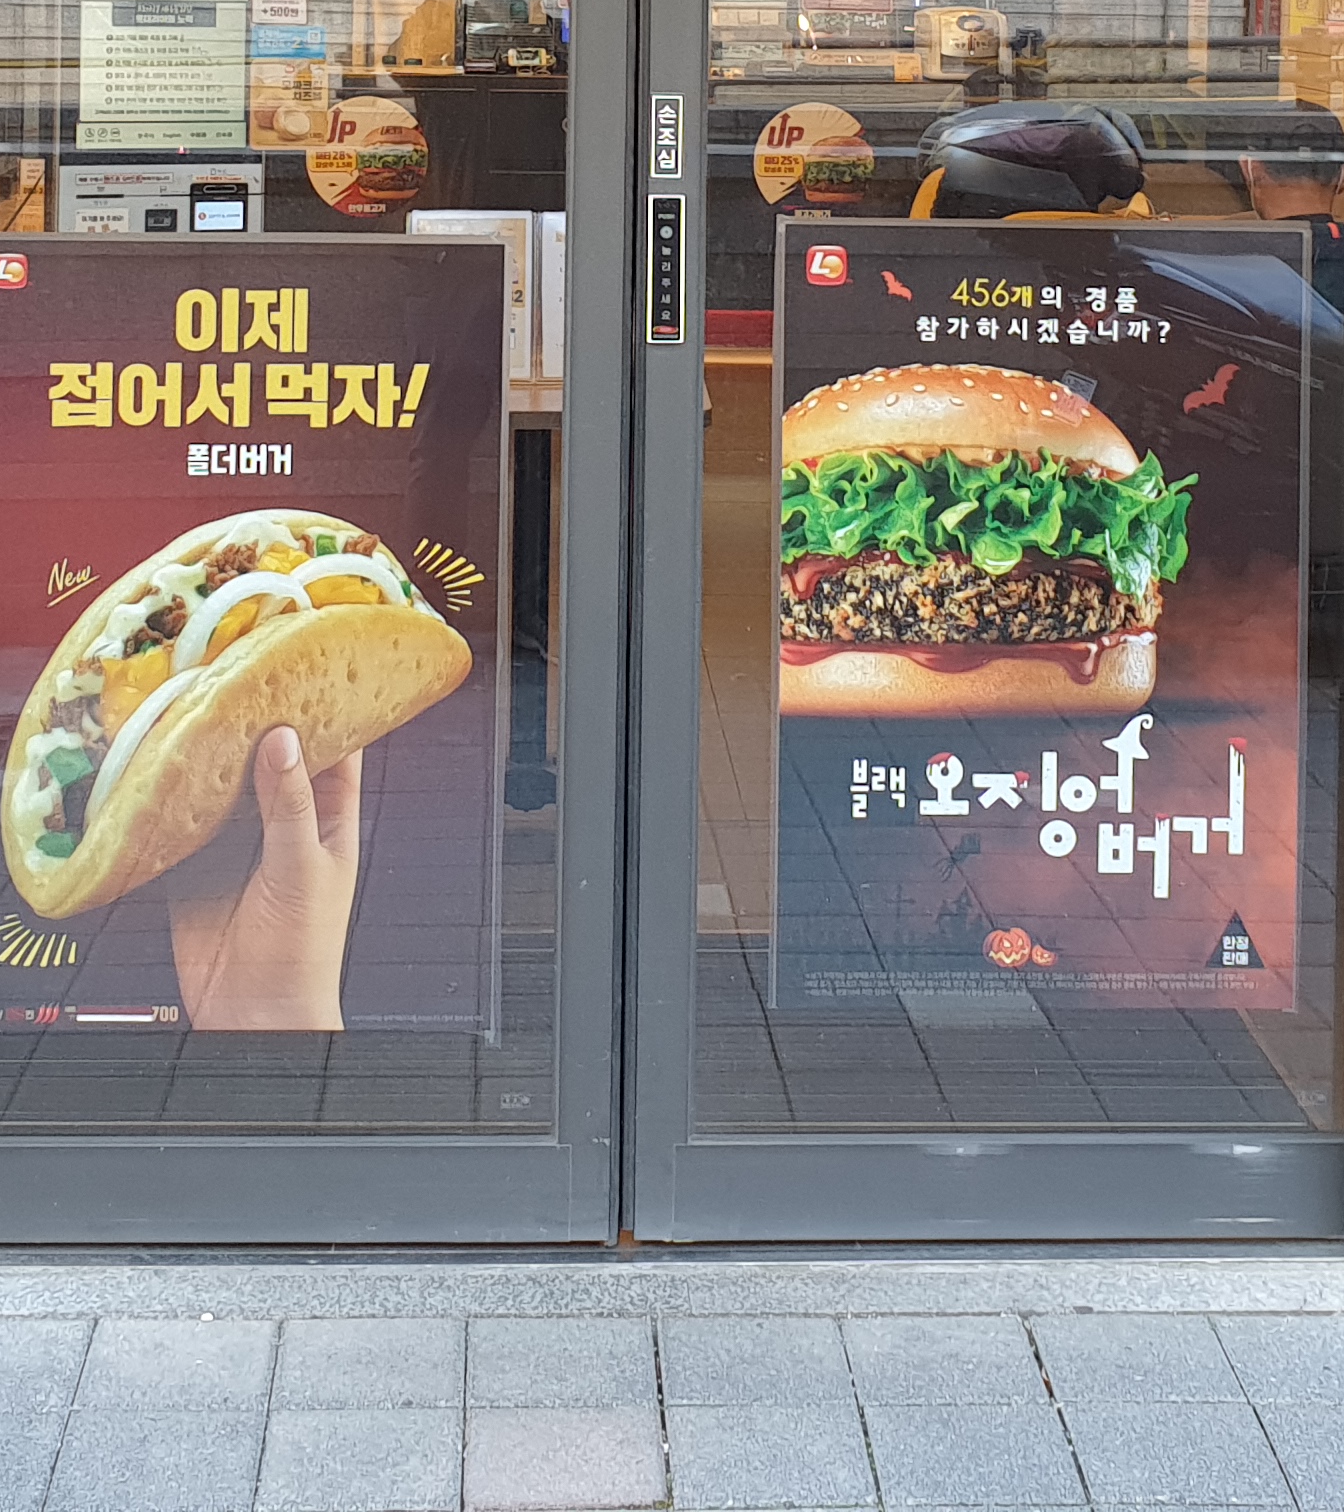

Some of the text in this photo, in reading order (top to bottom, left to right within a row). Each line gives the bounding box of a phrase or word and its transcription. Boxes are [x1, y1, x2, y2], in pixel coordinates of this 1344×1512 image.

[658, 104, 677, 169] 손조심
[175, 287, 309, 353] 이제
[916, 317, 1171, 345] 참가하시겠습니까?
[1085, 287, 1138, 314] 경품
[48, 362, 430, 429] 접어서 먹자!
[188, 444, 293, 476] 폴더버거
[48, 558, 93, 594] New
[850, 713, 1154, 858] 블랙 오징어
[1097, 737, 1246, 899] 버거
